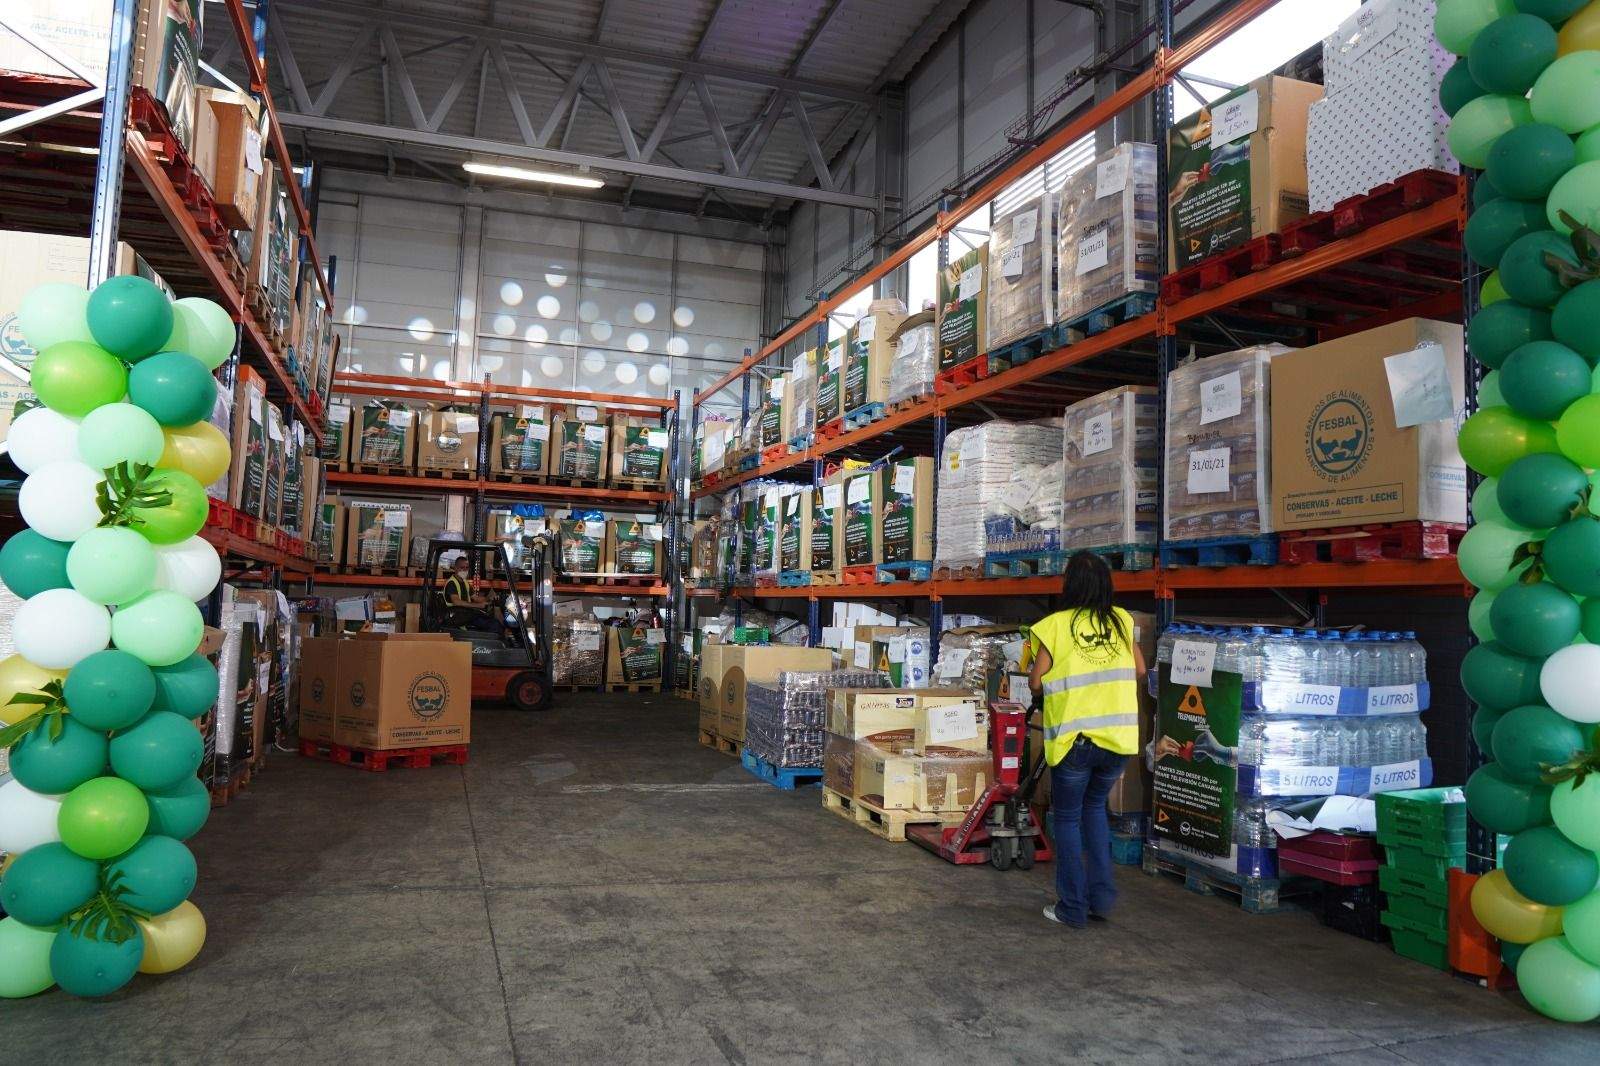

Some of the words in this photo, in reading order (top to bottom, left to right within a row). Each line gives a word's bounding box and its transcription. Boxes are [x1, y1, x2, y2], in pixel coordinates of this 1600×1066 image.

[1305, 399, 1326, 438] BANCOS
[1326, 391, 1337, 401] DE
[1338, 390, 1375, 426] ALIMENTOS
[1319, 415, 1358, 431] FESBAL
[1192, 458, 1225, 472] 31/01/21
[1286, 499, 1329, 512] CONSERVAS
[1336, 496, 1364, 507] ACEITE
[1370, 491, 1399, 503] LECHE
[1286, 693, 1293, 704] 5
[1295, 693, 1334, 706] LITROS
[1371, 695, 1378, 706] 5
[1380, 693, 1414, 706] LITROS
[1284, 775, 1292, 786] 5
[1293, 774, 1334, 787] LITROS
[1374, 774, 1381, 785] 5
[1382, 769, 1416, 784] LITROS
[964, 791, 990, 833] DINAKSA
